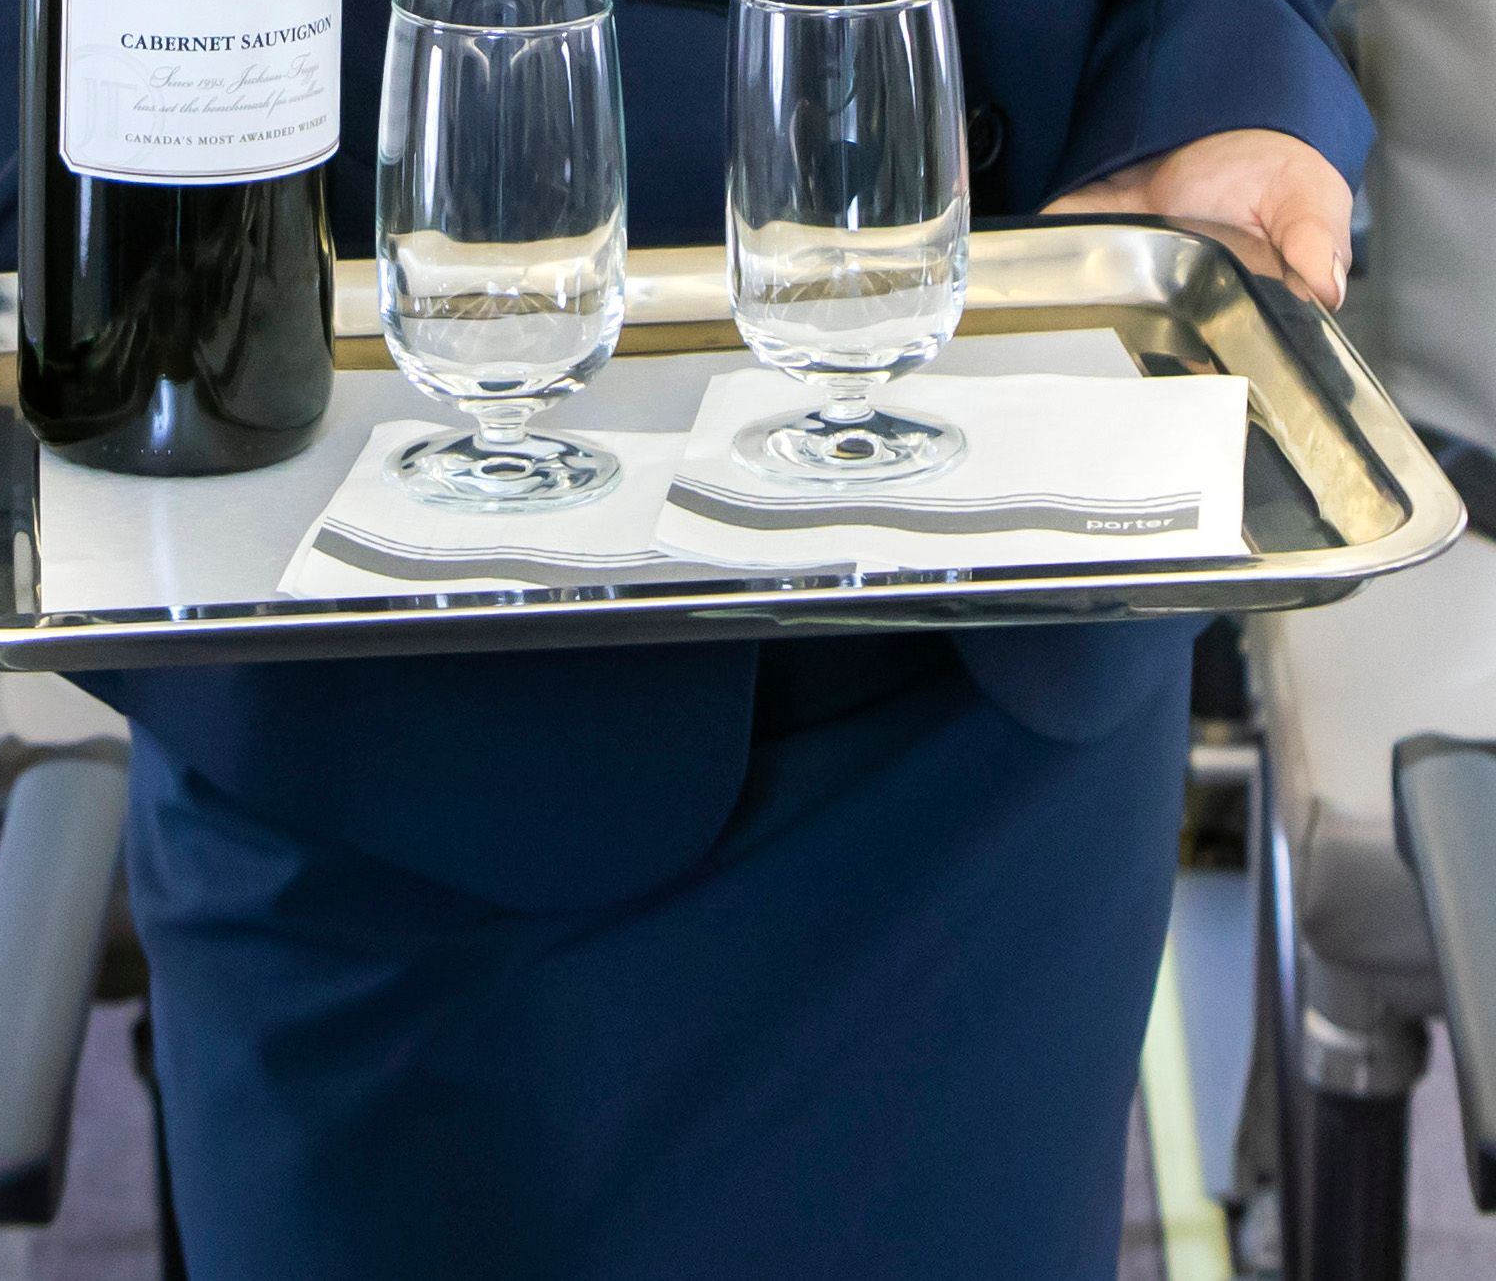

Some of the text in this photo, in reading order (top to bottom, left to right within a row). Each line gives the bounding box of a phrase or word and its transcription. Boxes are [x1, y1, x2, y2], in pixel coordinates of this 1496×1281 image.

[120, 14, 333, 52] CABERNET SAUVIGNON
[125, 132, 193, 146] CANADA'S
[197, 134, 235, 146] MOST
[239, 126, 296, 144] AWARDED
[1085, 517, 1175, 530] porter
